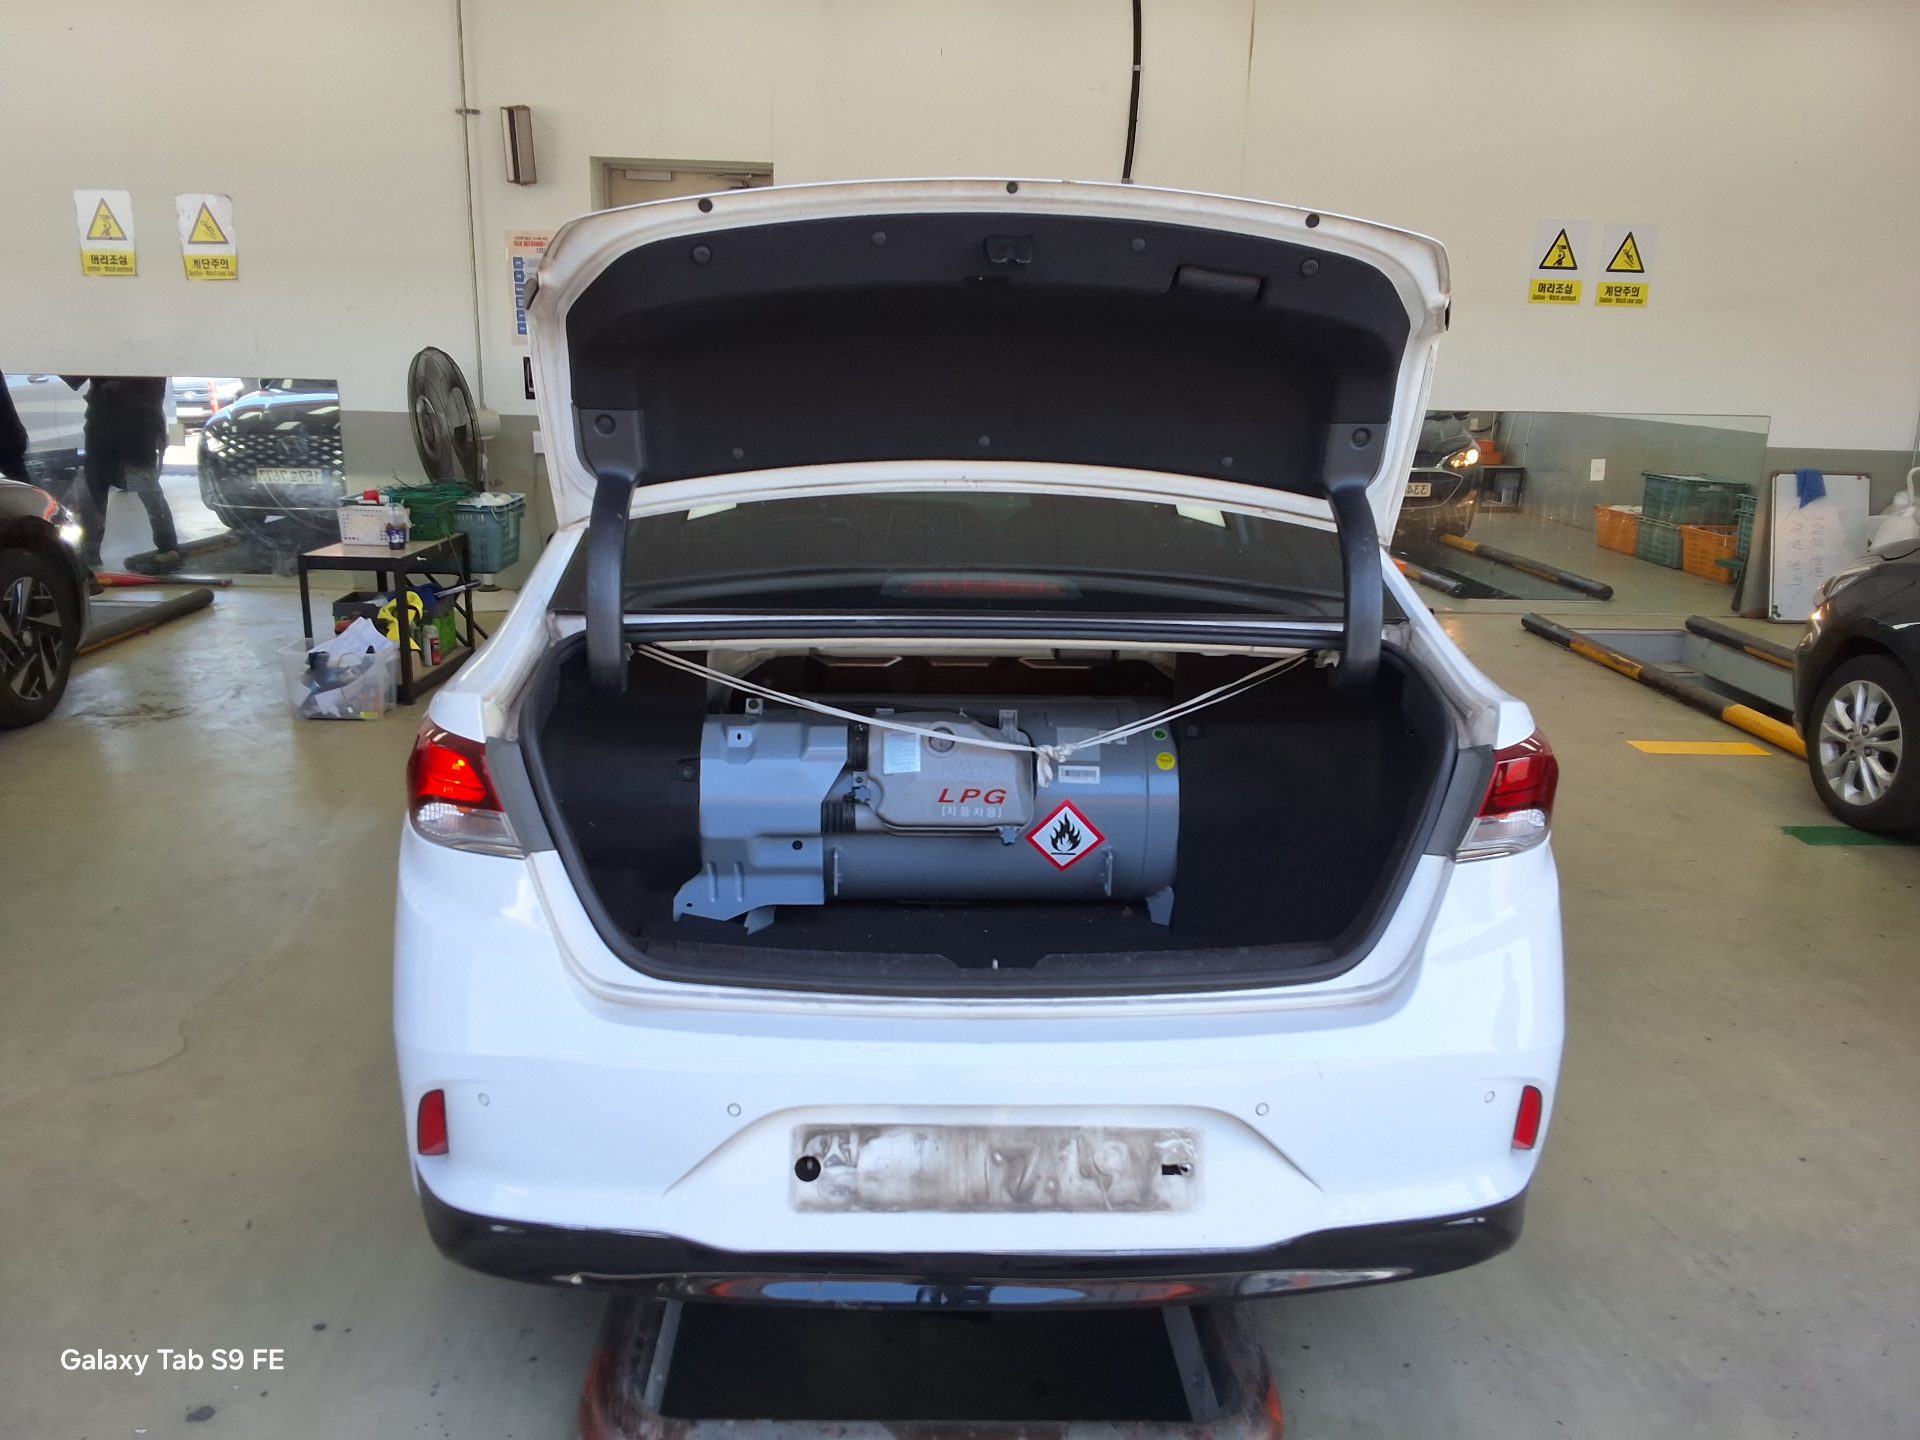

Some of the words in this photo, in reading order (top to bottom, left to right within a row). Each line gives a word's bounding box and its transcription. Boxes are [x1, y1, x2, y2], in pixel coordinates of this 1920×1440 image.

[90, 254, 128, 265] 머리조심
[1538, 283, 1573, 294] 머리조심
[1605, 285, 1640, 297] 계단주의
[937, 788, 1007, 804] LPG
